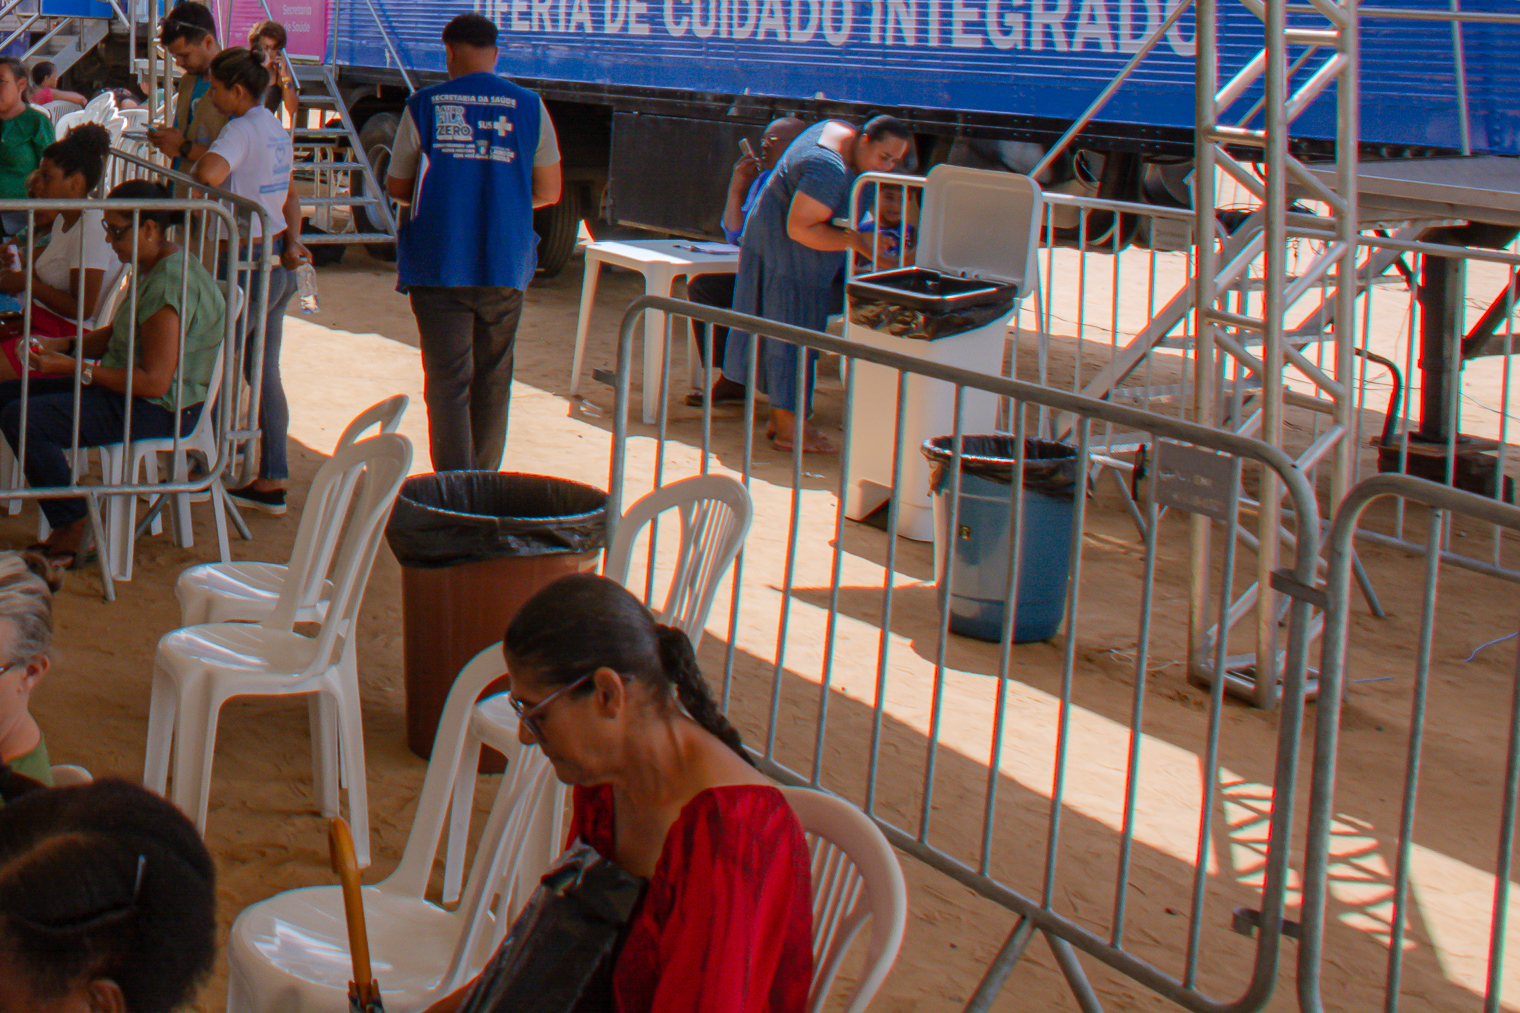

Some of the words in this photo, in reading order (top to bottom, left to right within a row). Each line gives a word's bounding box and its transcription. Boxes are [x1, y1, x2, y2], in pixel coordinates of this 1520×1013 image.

[282, 4, 312, 16] Secretaria
[292, 21, 310, 33] Saúde
[431, 94, 476, 103] SECRETARIA
[477, 95, 489, 103] DA
[490, 96, 517, 106] SAÚDE
[436, 125, 472, 136] ZERO
